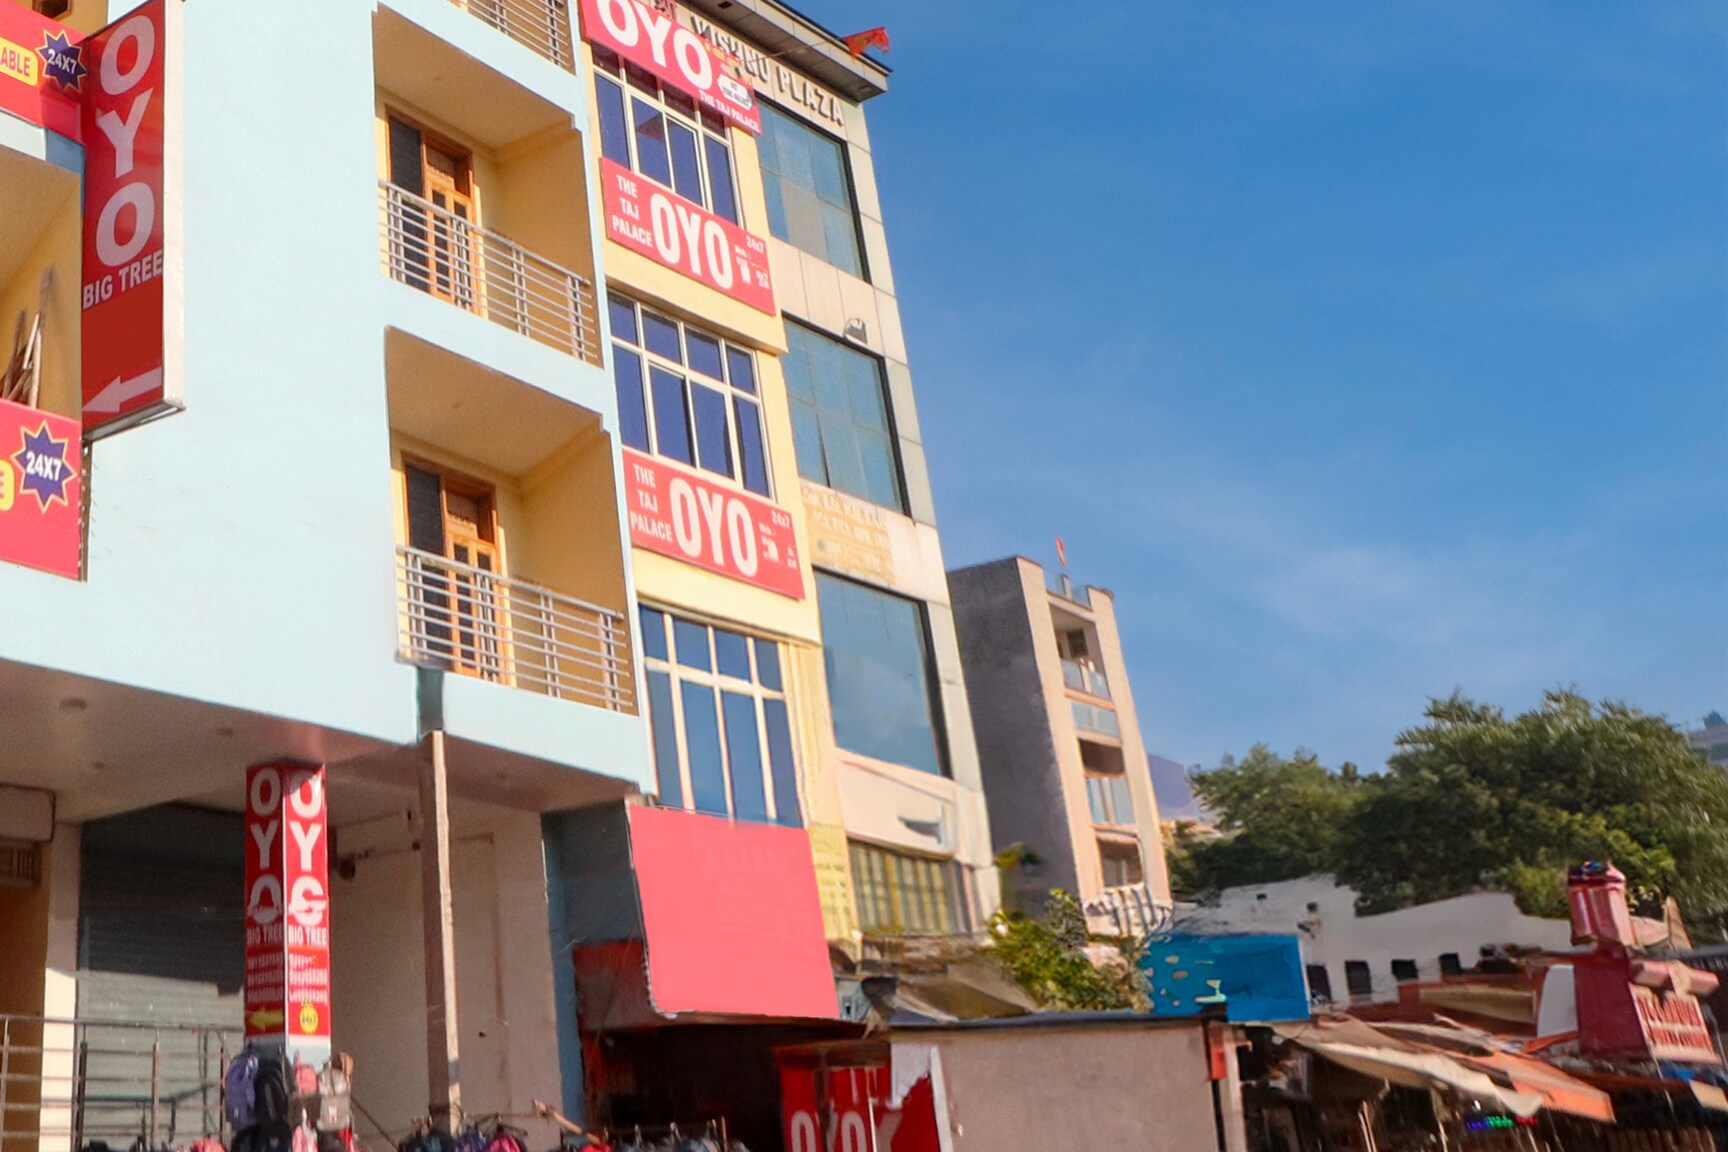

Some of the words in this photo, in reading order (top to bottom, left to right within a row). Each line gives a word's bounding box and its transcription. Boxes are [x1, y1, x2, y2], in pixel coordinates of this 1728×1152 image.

[47, 47, 78, 75] 24X7
[698, 89, 716, 108] THE
[715, 96, 731, 116] TAJ
[731, 105, 761, 134] PALACE
[776, 65, 845, 127] PLAZA
[95, 14, 156, 267] OYO
[616, 174, 638, 198] THE
[619, 196, 640, 221] TAJ
[612, 215, 654, 248] PALACE
[650, 192, 734, 290] OYO
[83, 275, 114, 311] BIG
[118, 252, 164, 290] TREE
[25, 450, 63, 482] 24X7
[633, 463, 656, 489] THE
[637, 489, 658, 513] TAJ
[630, 510, 673, 543] PALACE
[669, 477, 758, 578] OYO
[305, 925, 328, 946] TREE
